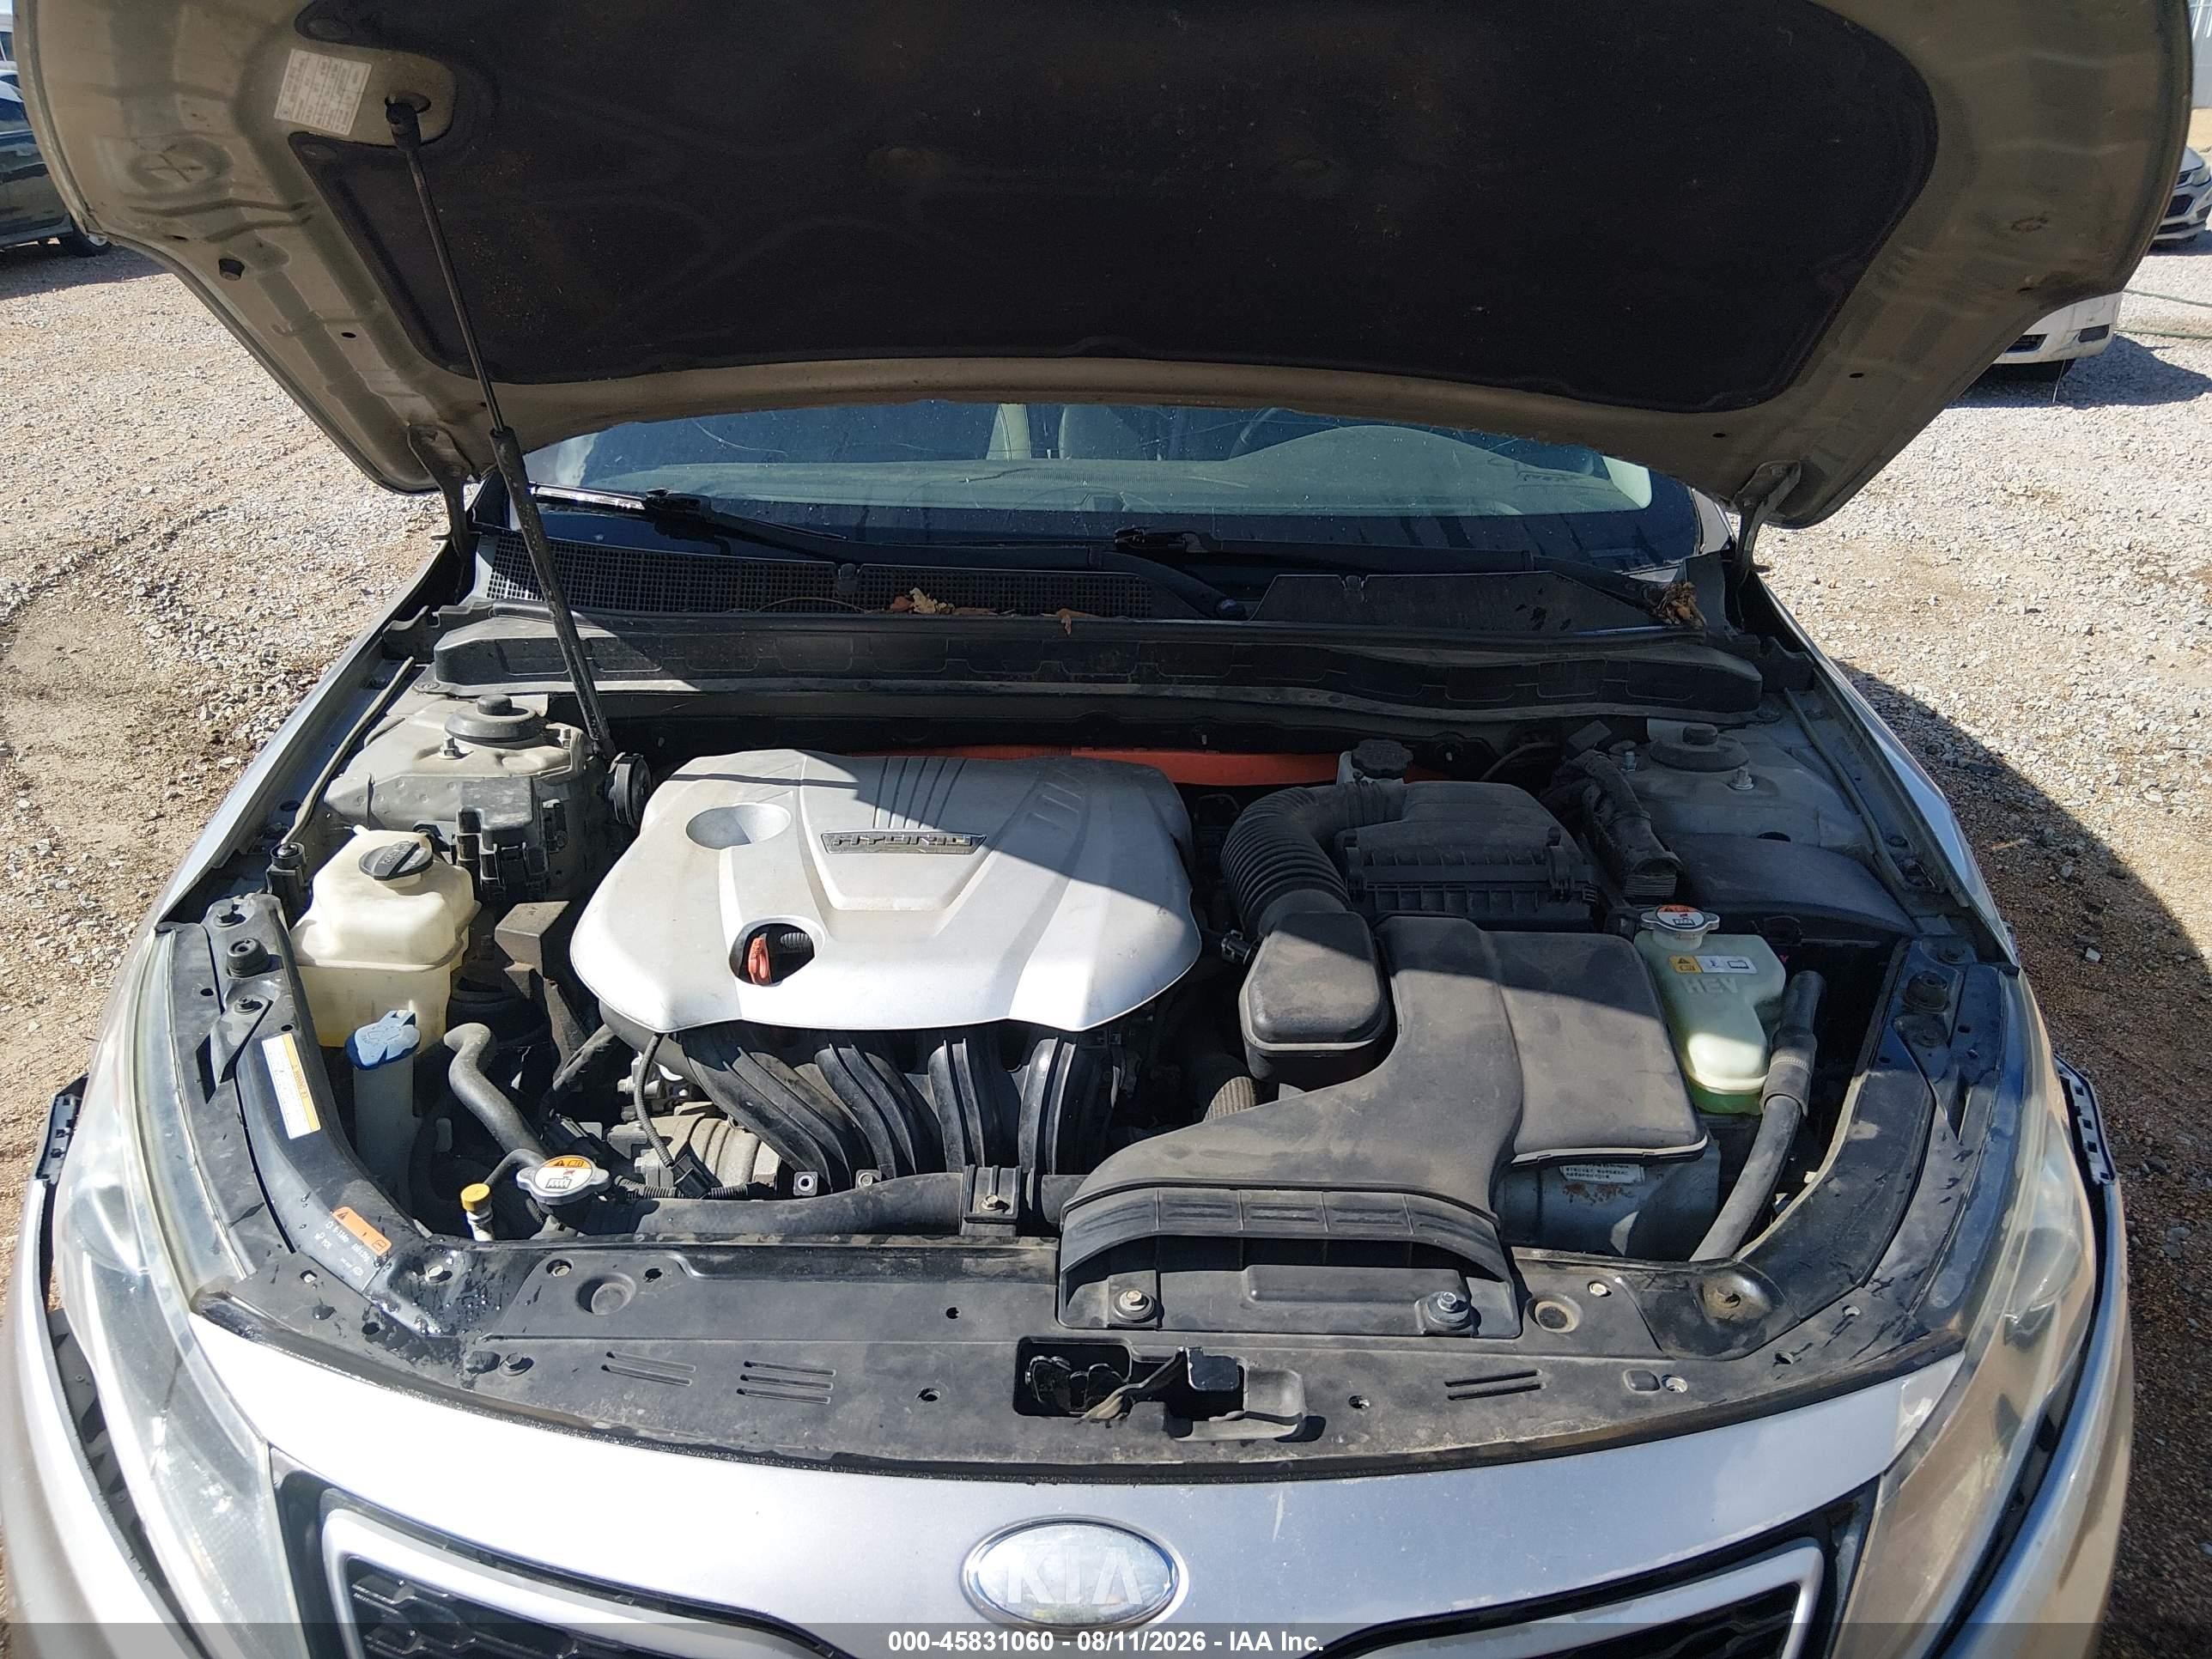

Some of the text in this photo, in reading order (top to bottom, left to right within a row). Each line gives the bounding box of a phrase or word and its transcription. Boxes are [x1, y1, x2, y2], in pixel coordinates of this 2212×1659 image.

[831, 835, 972, 847] HYBRID
[1681, 977, 1739, 994] HEV
[1006, 1544, 1143, 1605] KIA
